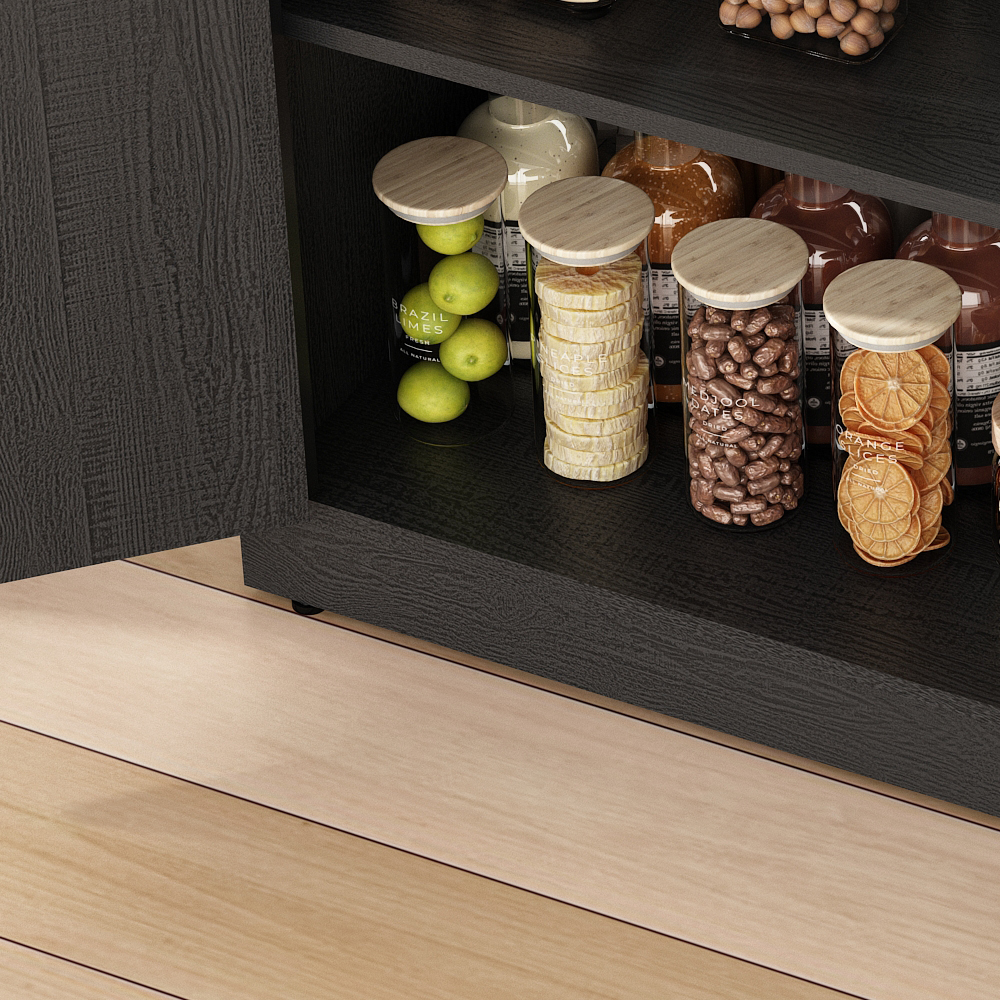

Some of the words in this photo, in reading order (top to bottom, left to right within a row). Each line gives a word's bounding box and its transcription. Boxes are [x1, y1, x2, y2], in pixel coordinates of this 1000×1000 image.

[391, 297, 449, 322] BRAZIL
[395, 312, 444, 335] LIMES
[405, 334, 430, 346] FRESH
[410, 352, 441, 363] NATURAL
[682, 376, 760, 408] MEDJOOL
[691, 397, 743, 420] DATES
[702, 419, 728, 432] DRIED
[835, 424, 904, 451] ORANGE
[840, 439, 898, 464] SLICES
[853, 463, 878, 475] DRIED
